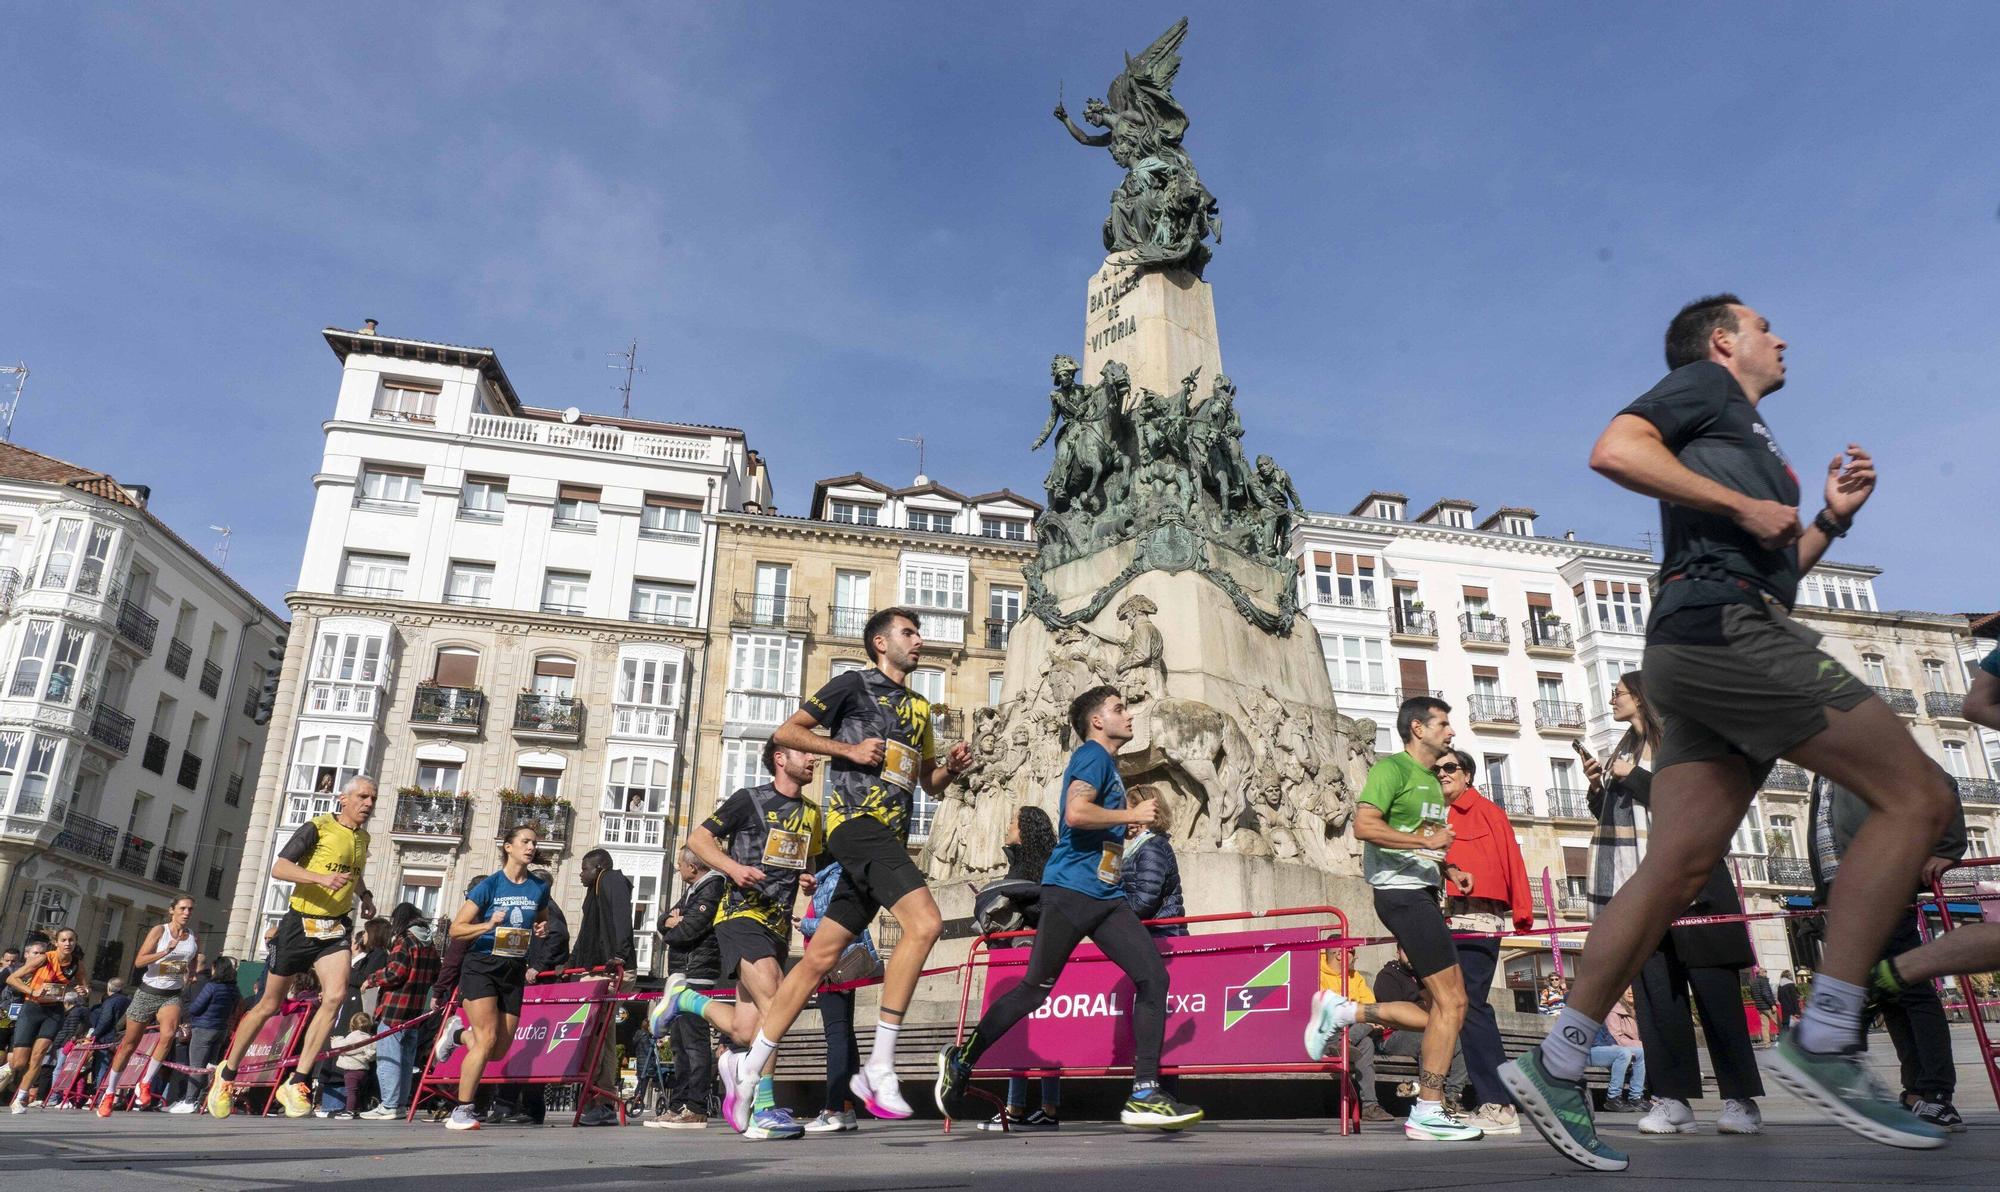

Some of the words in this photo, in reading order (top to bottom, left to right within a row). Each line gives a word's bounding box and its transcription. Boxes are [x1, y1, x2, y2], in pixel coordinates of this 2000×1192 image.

[1090, 271, 1140, 313] BATALLA
[1107, 305, 1120, 321] DE
[1091, 315, 1137, 353] VITORIA
[508, 934, 521, 945] 30
[1028, 993, 1123, 1020] BORAL
